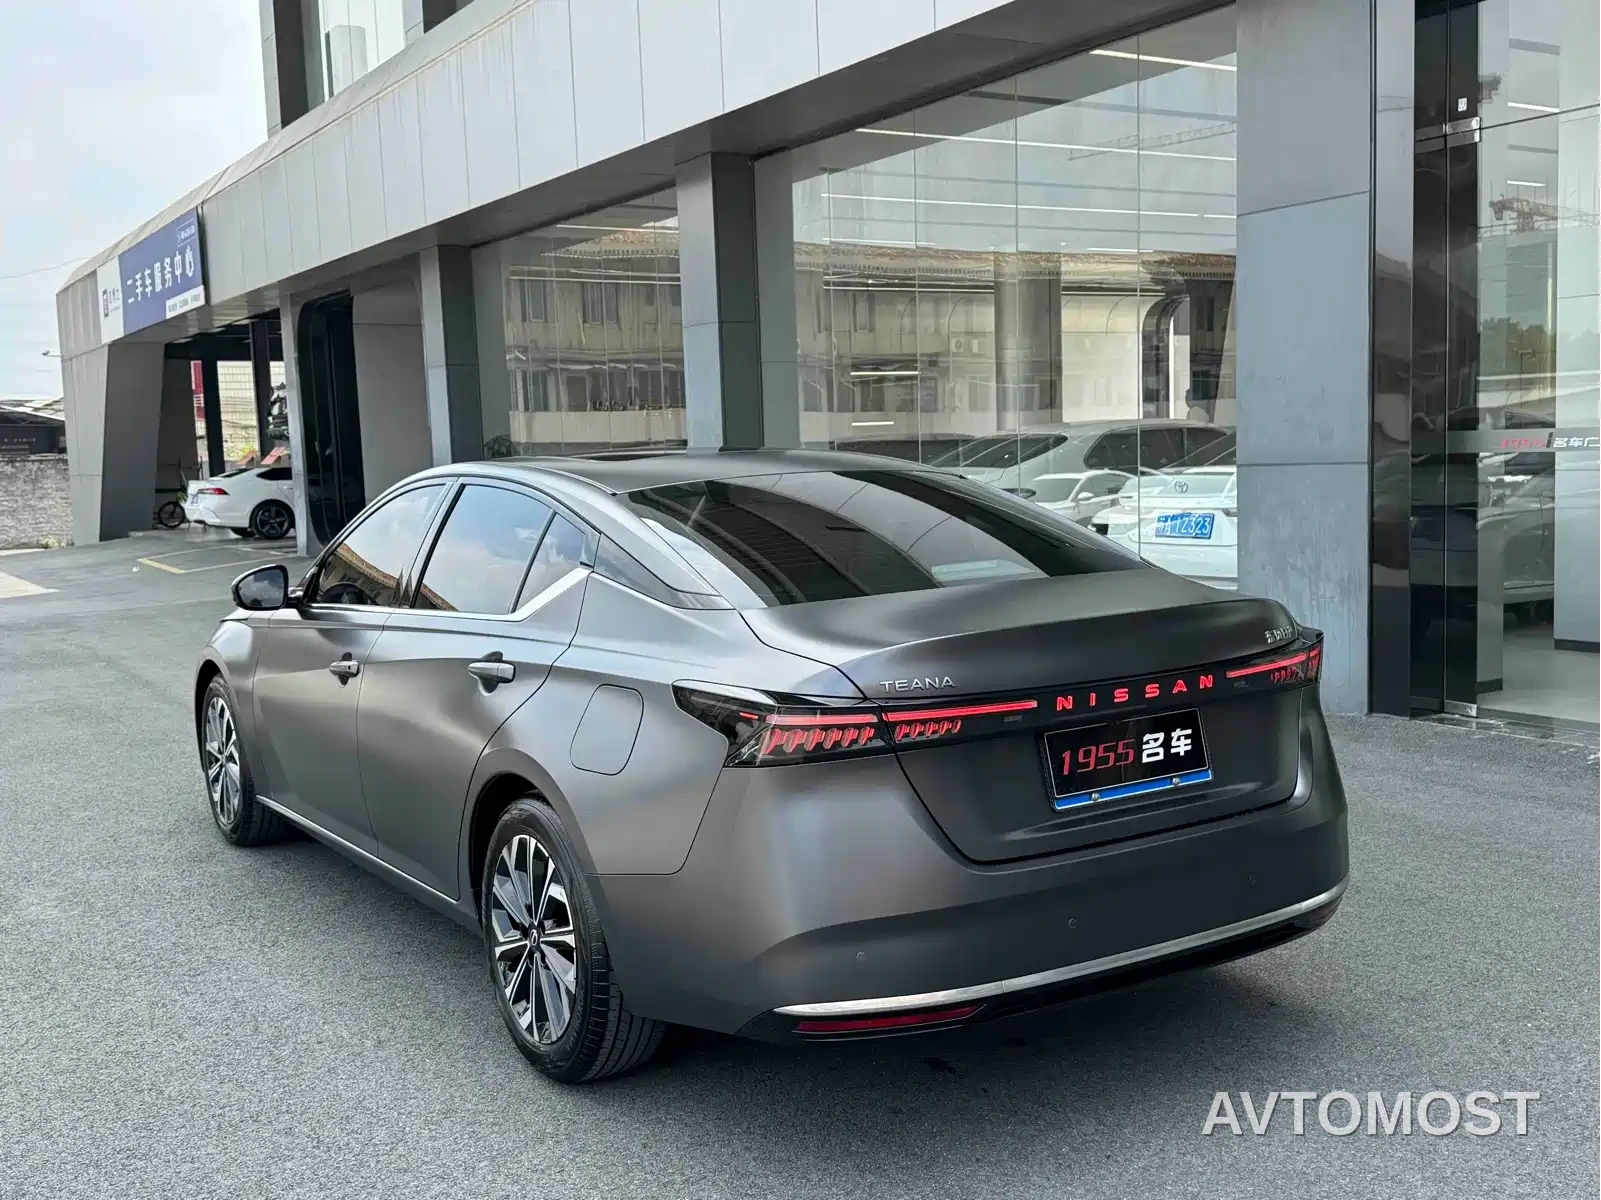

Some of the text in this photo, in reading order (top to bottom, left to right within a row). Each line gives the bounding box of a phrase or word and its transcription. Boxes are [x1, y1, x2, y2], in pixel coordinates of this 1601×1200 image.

[126, 245, 195, 304] 二手车服务中心
[1553, 436, 1600, 448] 名车广
[879, 676, 957, 693] TEANA
[1056, 674, 1213, 711] NISSAN
[1061, 727, 1193, 776] 1955 名车
